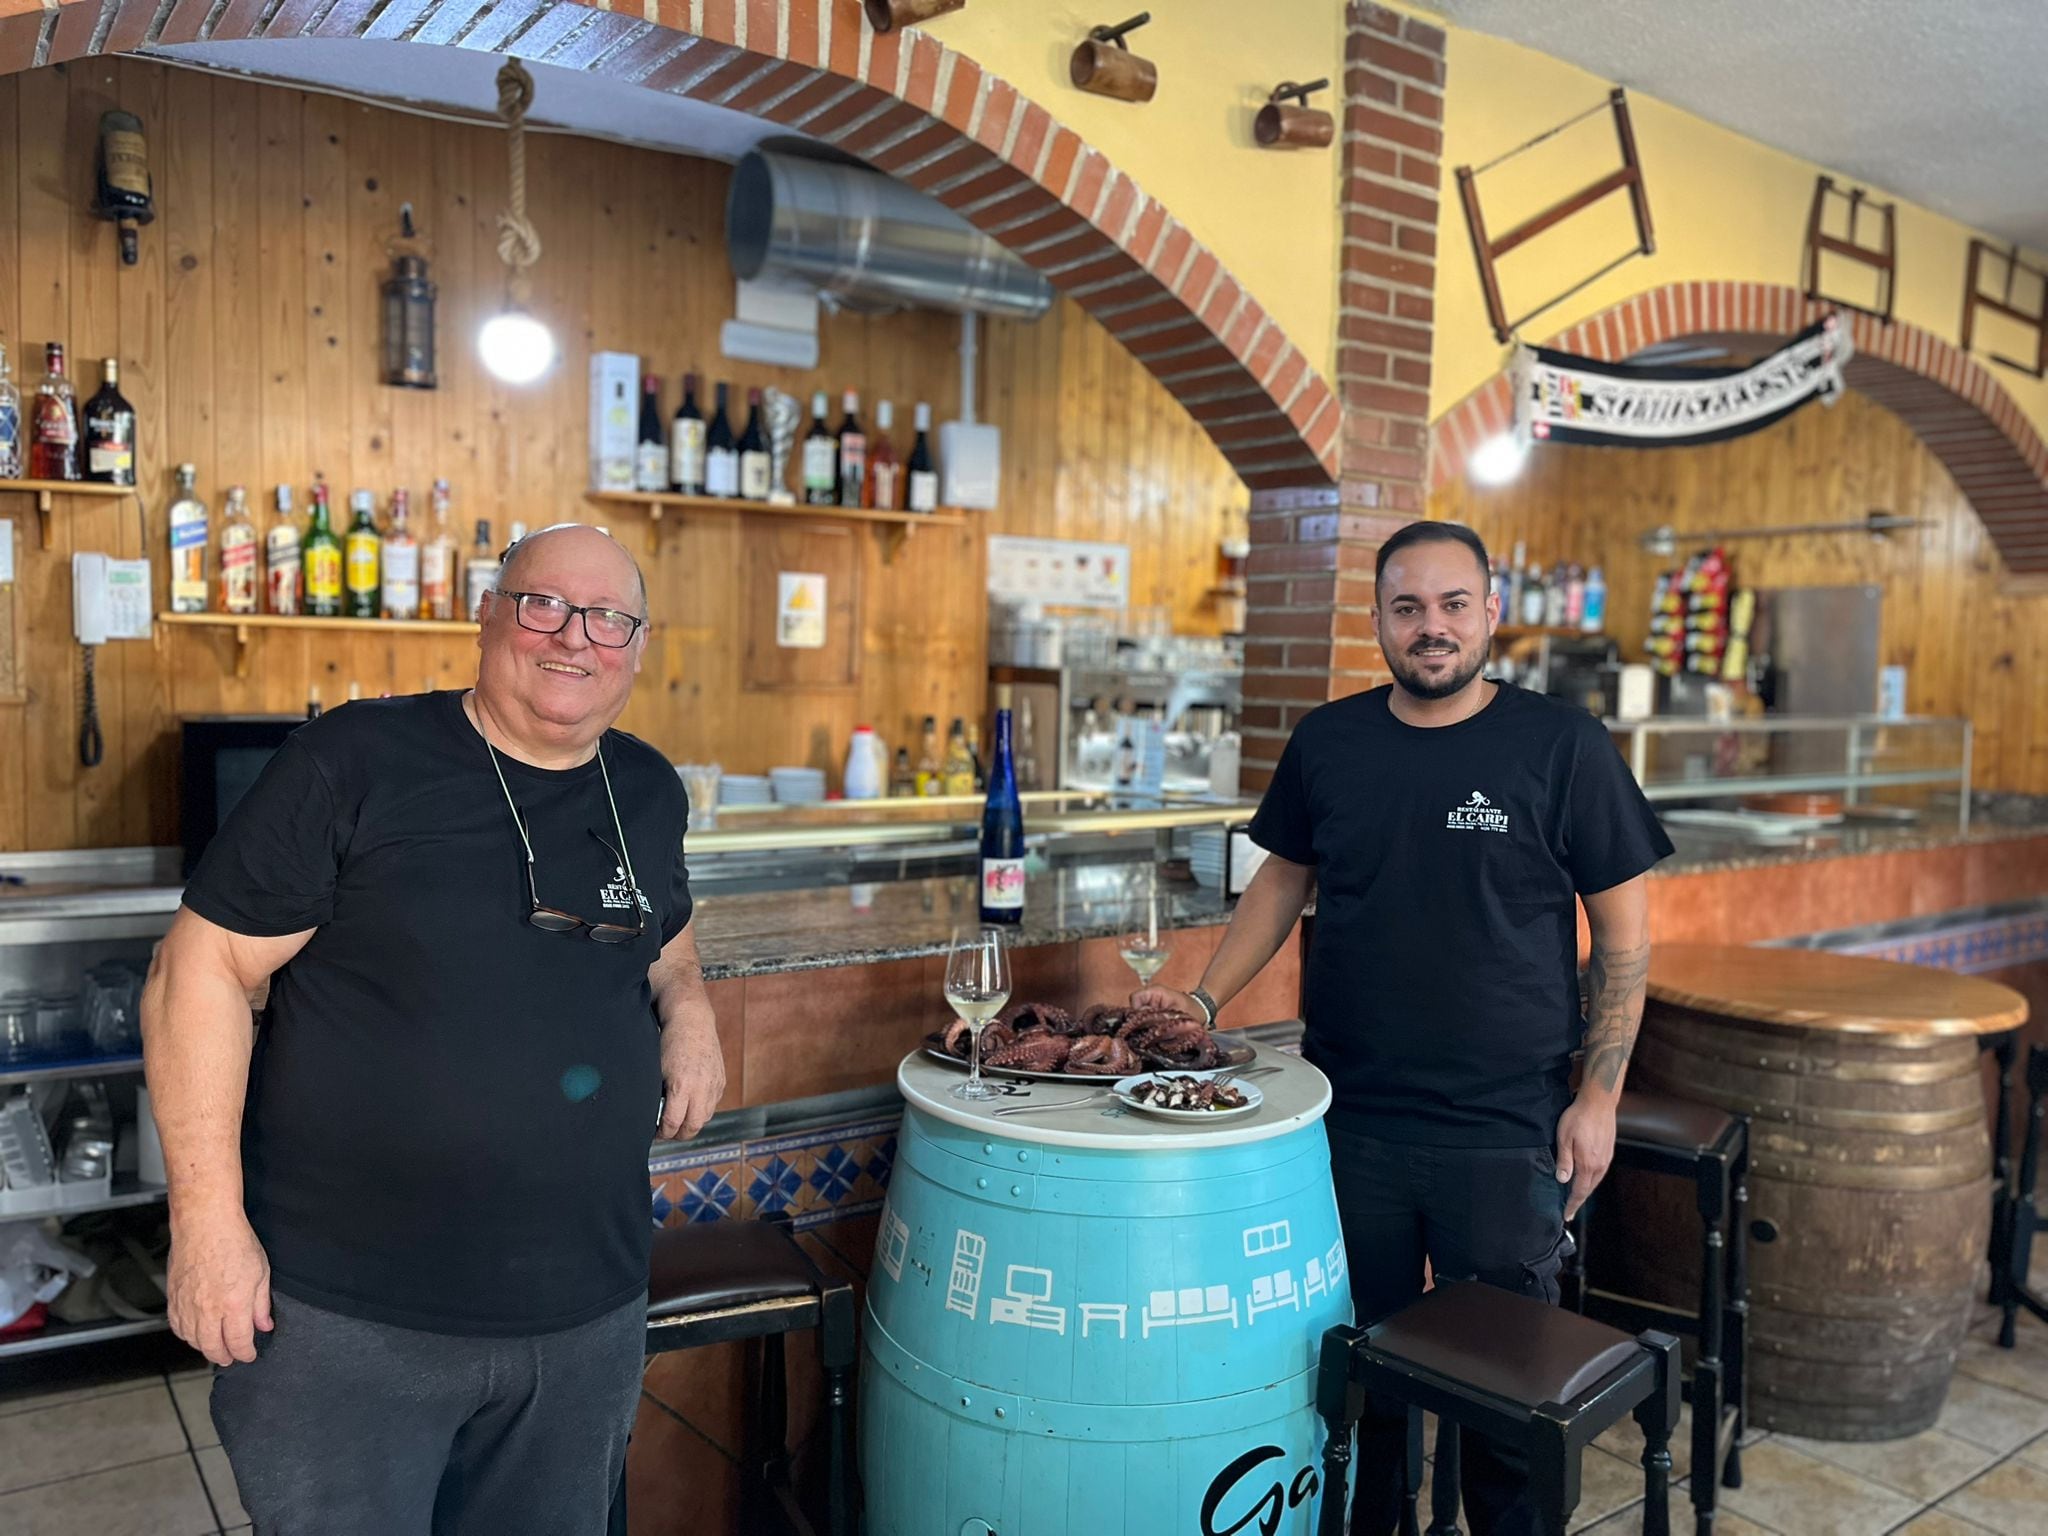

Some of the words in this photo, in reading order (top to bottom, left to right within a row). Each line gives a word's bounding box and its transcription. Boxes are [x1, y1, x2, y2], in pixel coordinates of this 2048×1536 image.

[1448, 811, 1464, 822] EL
[1466, 812, 1509, 825] CARPI
[600, 889, 618, 900] EL
